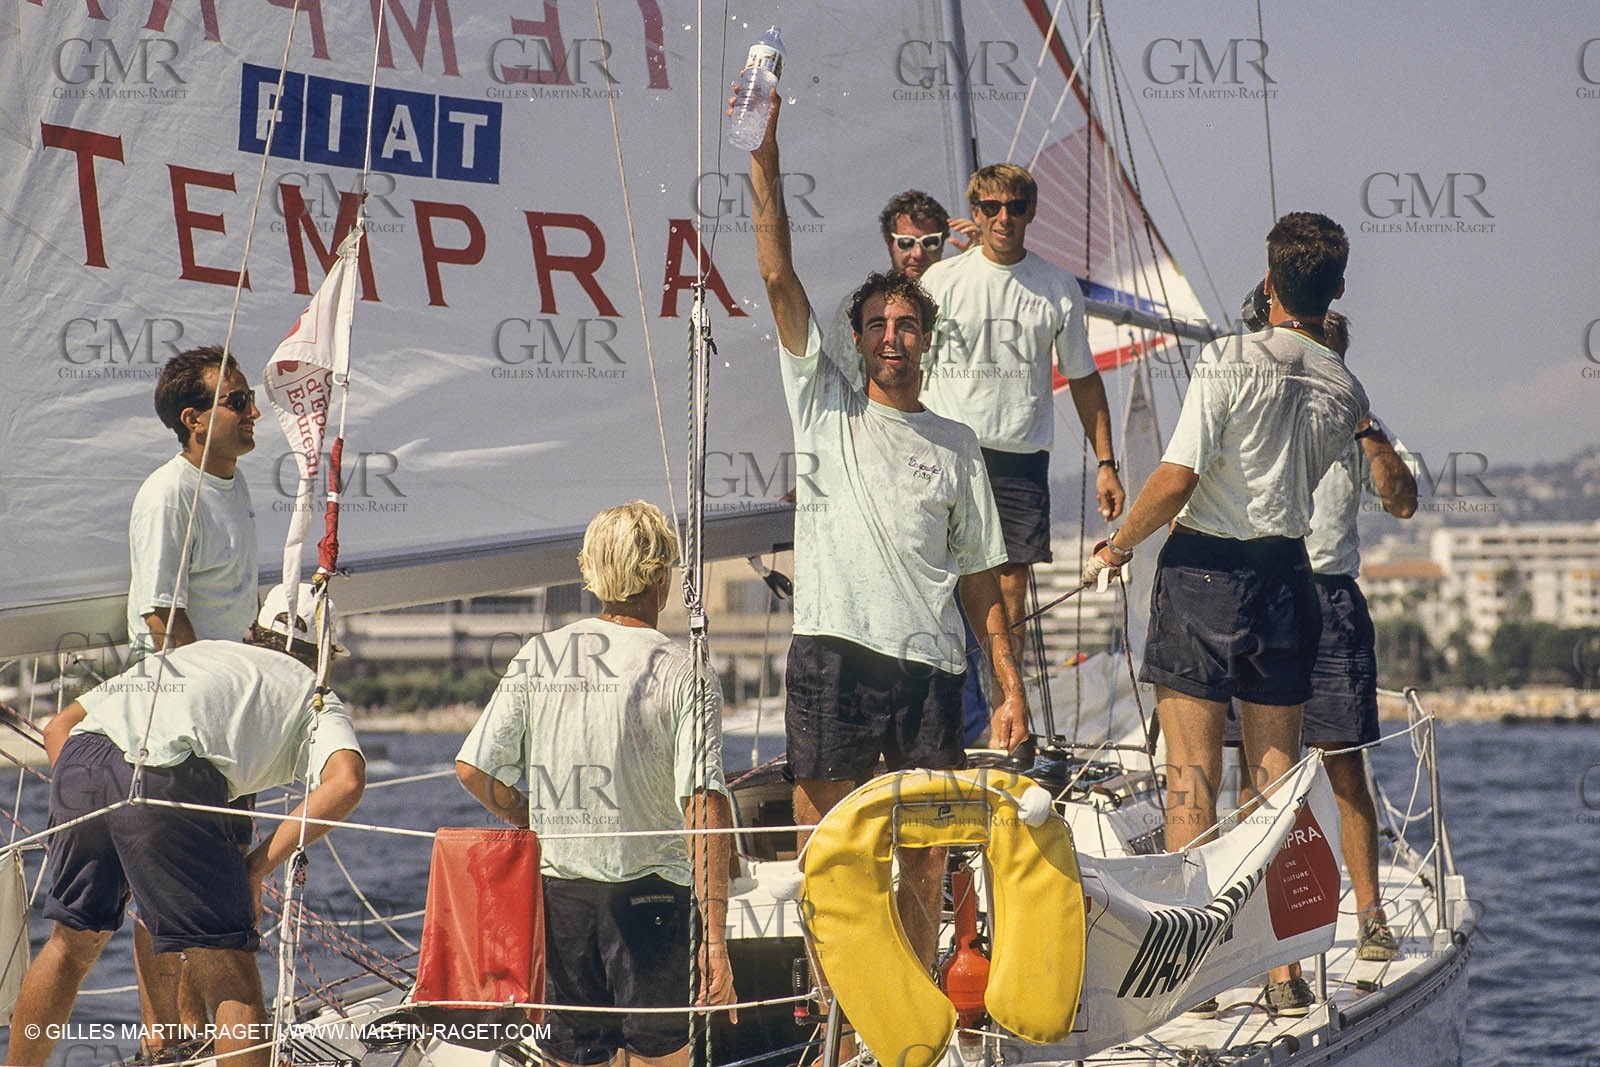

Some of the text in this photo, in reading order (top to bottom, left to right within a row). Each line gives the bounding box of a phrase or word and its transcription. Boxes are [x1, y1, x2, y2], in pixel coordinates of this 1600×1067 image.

[256, 82, 488, 168] FIAT
[40, 121, 748, 318] TEMPRA
[1292, 886, 1308, 895] BIEN
